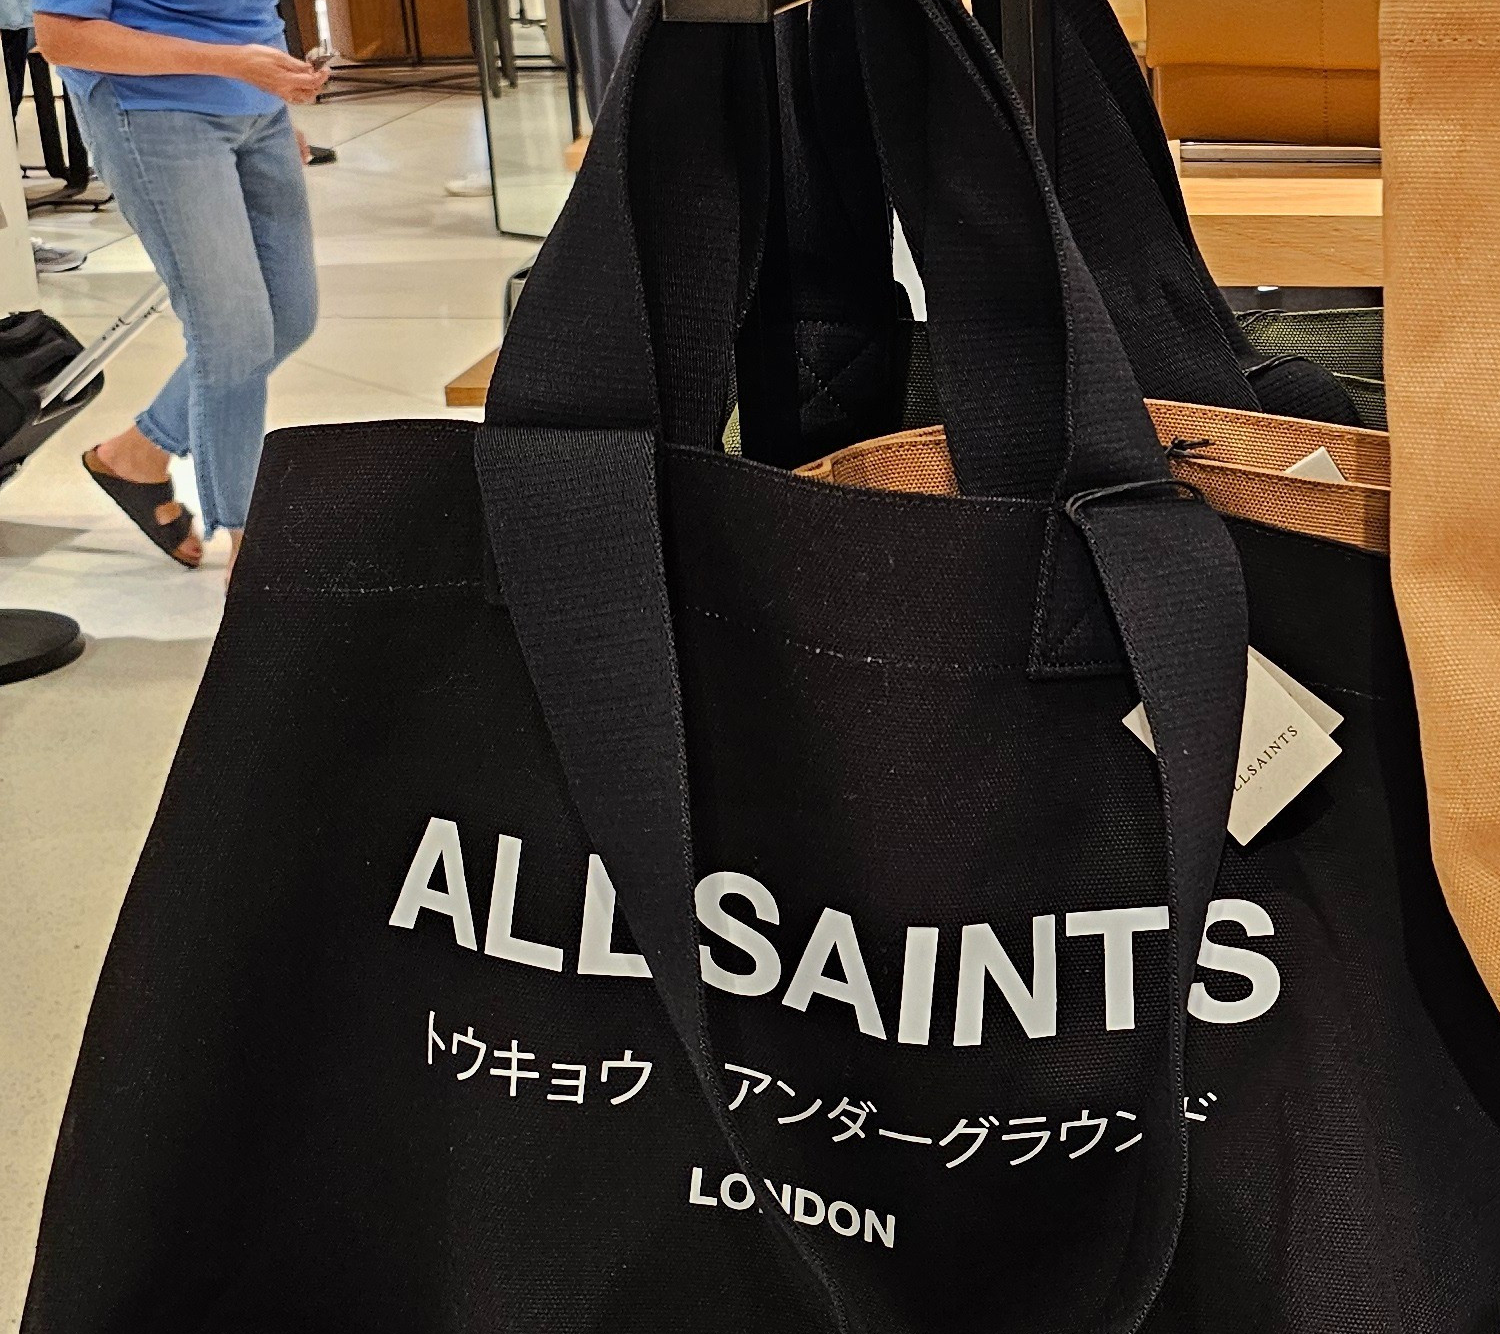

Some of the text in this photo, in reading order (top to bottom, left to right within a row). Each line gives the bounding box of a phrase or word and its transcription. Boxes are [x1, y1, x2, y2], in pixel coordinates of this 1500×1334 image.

[388, 816, 1281, 1046] ALLSAINTS
[427, 1010, 653, 1106] トウキョウ
